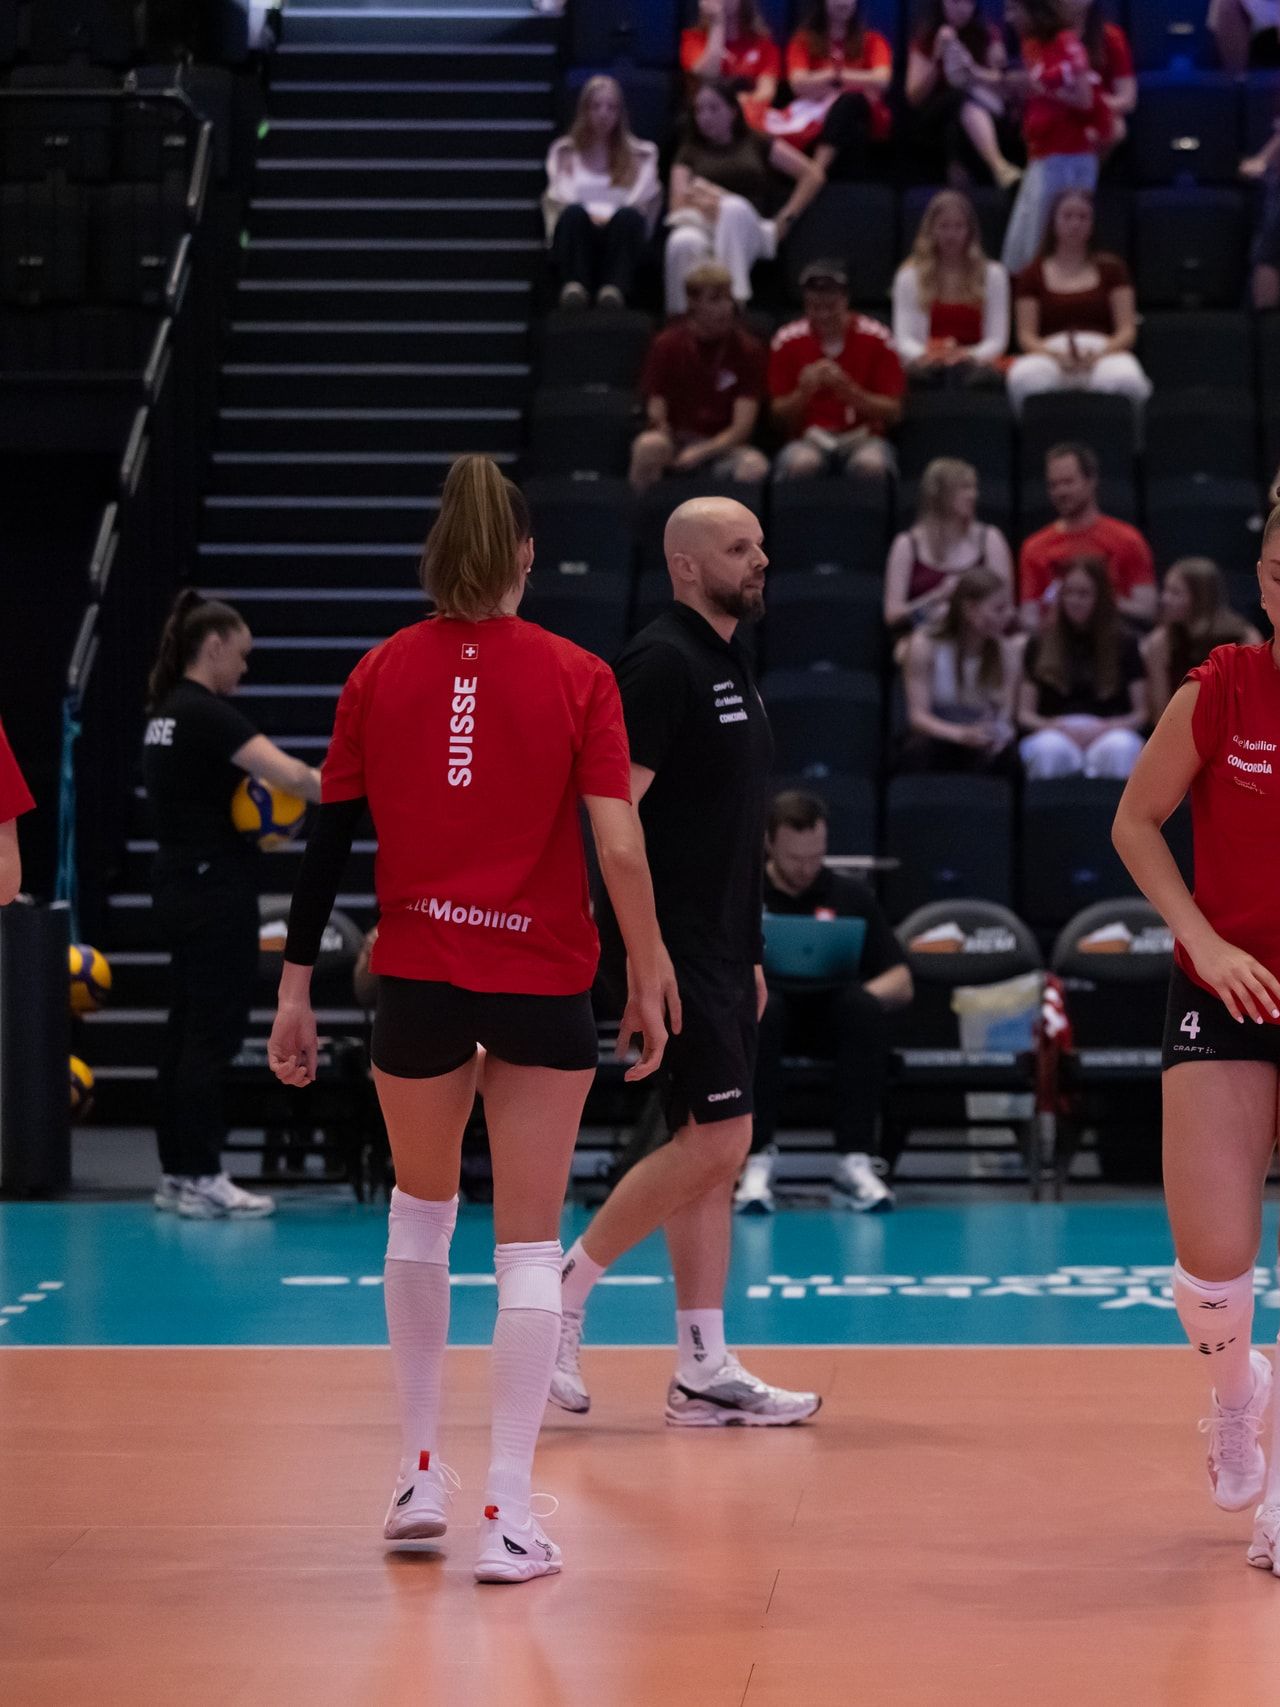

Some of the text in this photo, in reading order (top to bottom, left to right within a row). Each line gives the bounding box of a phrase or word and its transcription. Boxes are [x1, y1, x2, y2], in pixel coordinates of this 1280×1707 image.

[448, 676, 477, 787] SUISSE
[1180, 1010, 1201, 1040] 4
[1173, 1044, 1205, 1053] CRAFT
[707, 1089, 737, 1103] CRAFT
